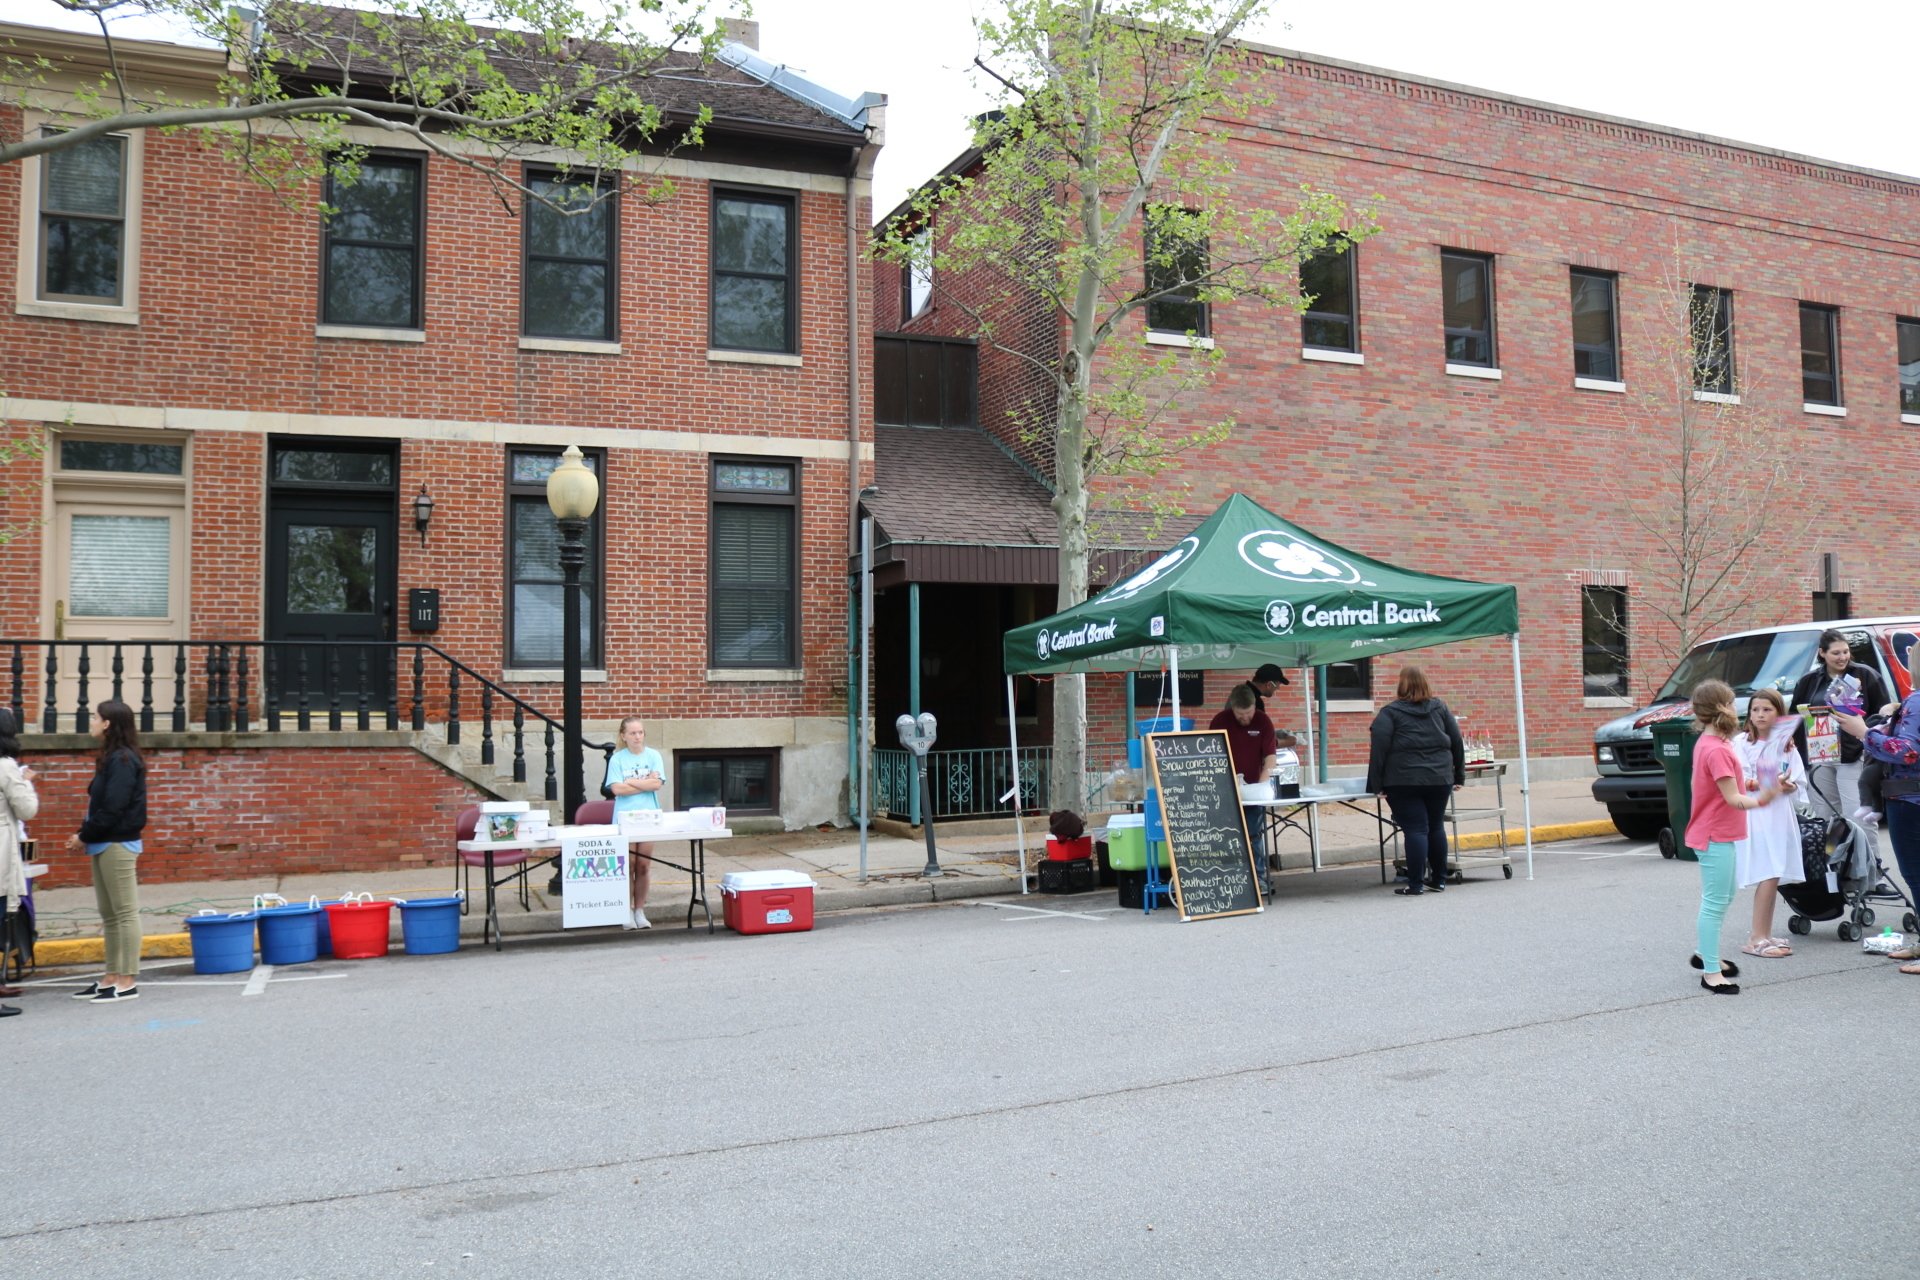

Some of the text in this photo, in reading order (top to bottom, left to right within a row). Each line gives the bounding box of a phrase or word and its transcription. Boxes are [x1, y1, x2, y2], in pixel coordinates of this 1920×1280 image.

[418, 609, 432, 621] 117
[1301, 600, 1442, 627] Central Bank
[1051, 617, 1118, 651] Central Bank
[578, 839, 612, 848] SODA &
[575, 848, 616, 857] COOKIES
[576, 901, 602, 909] Ticket
[603, 899, 623, 907] Each
